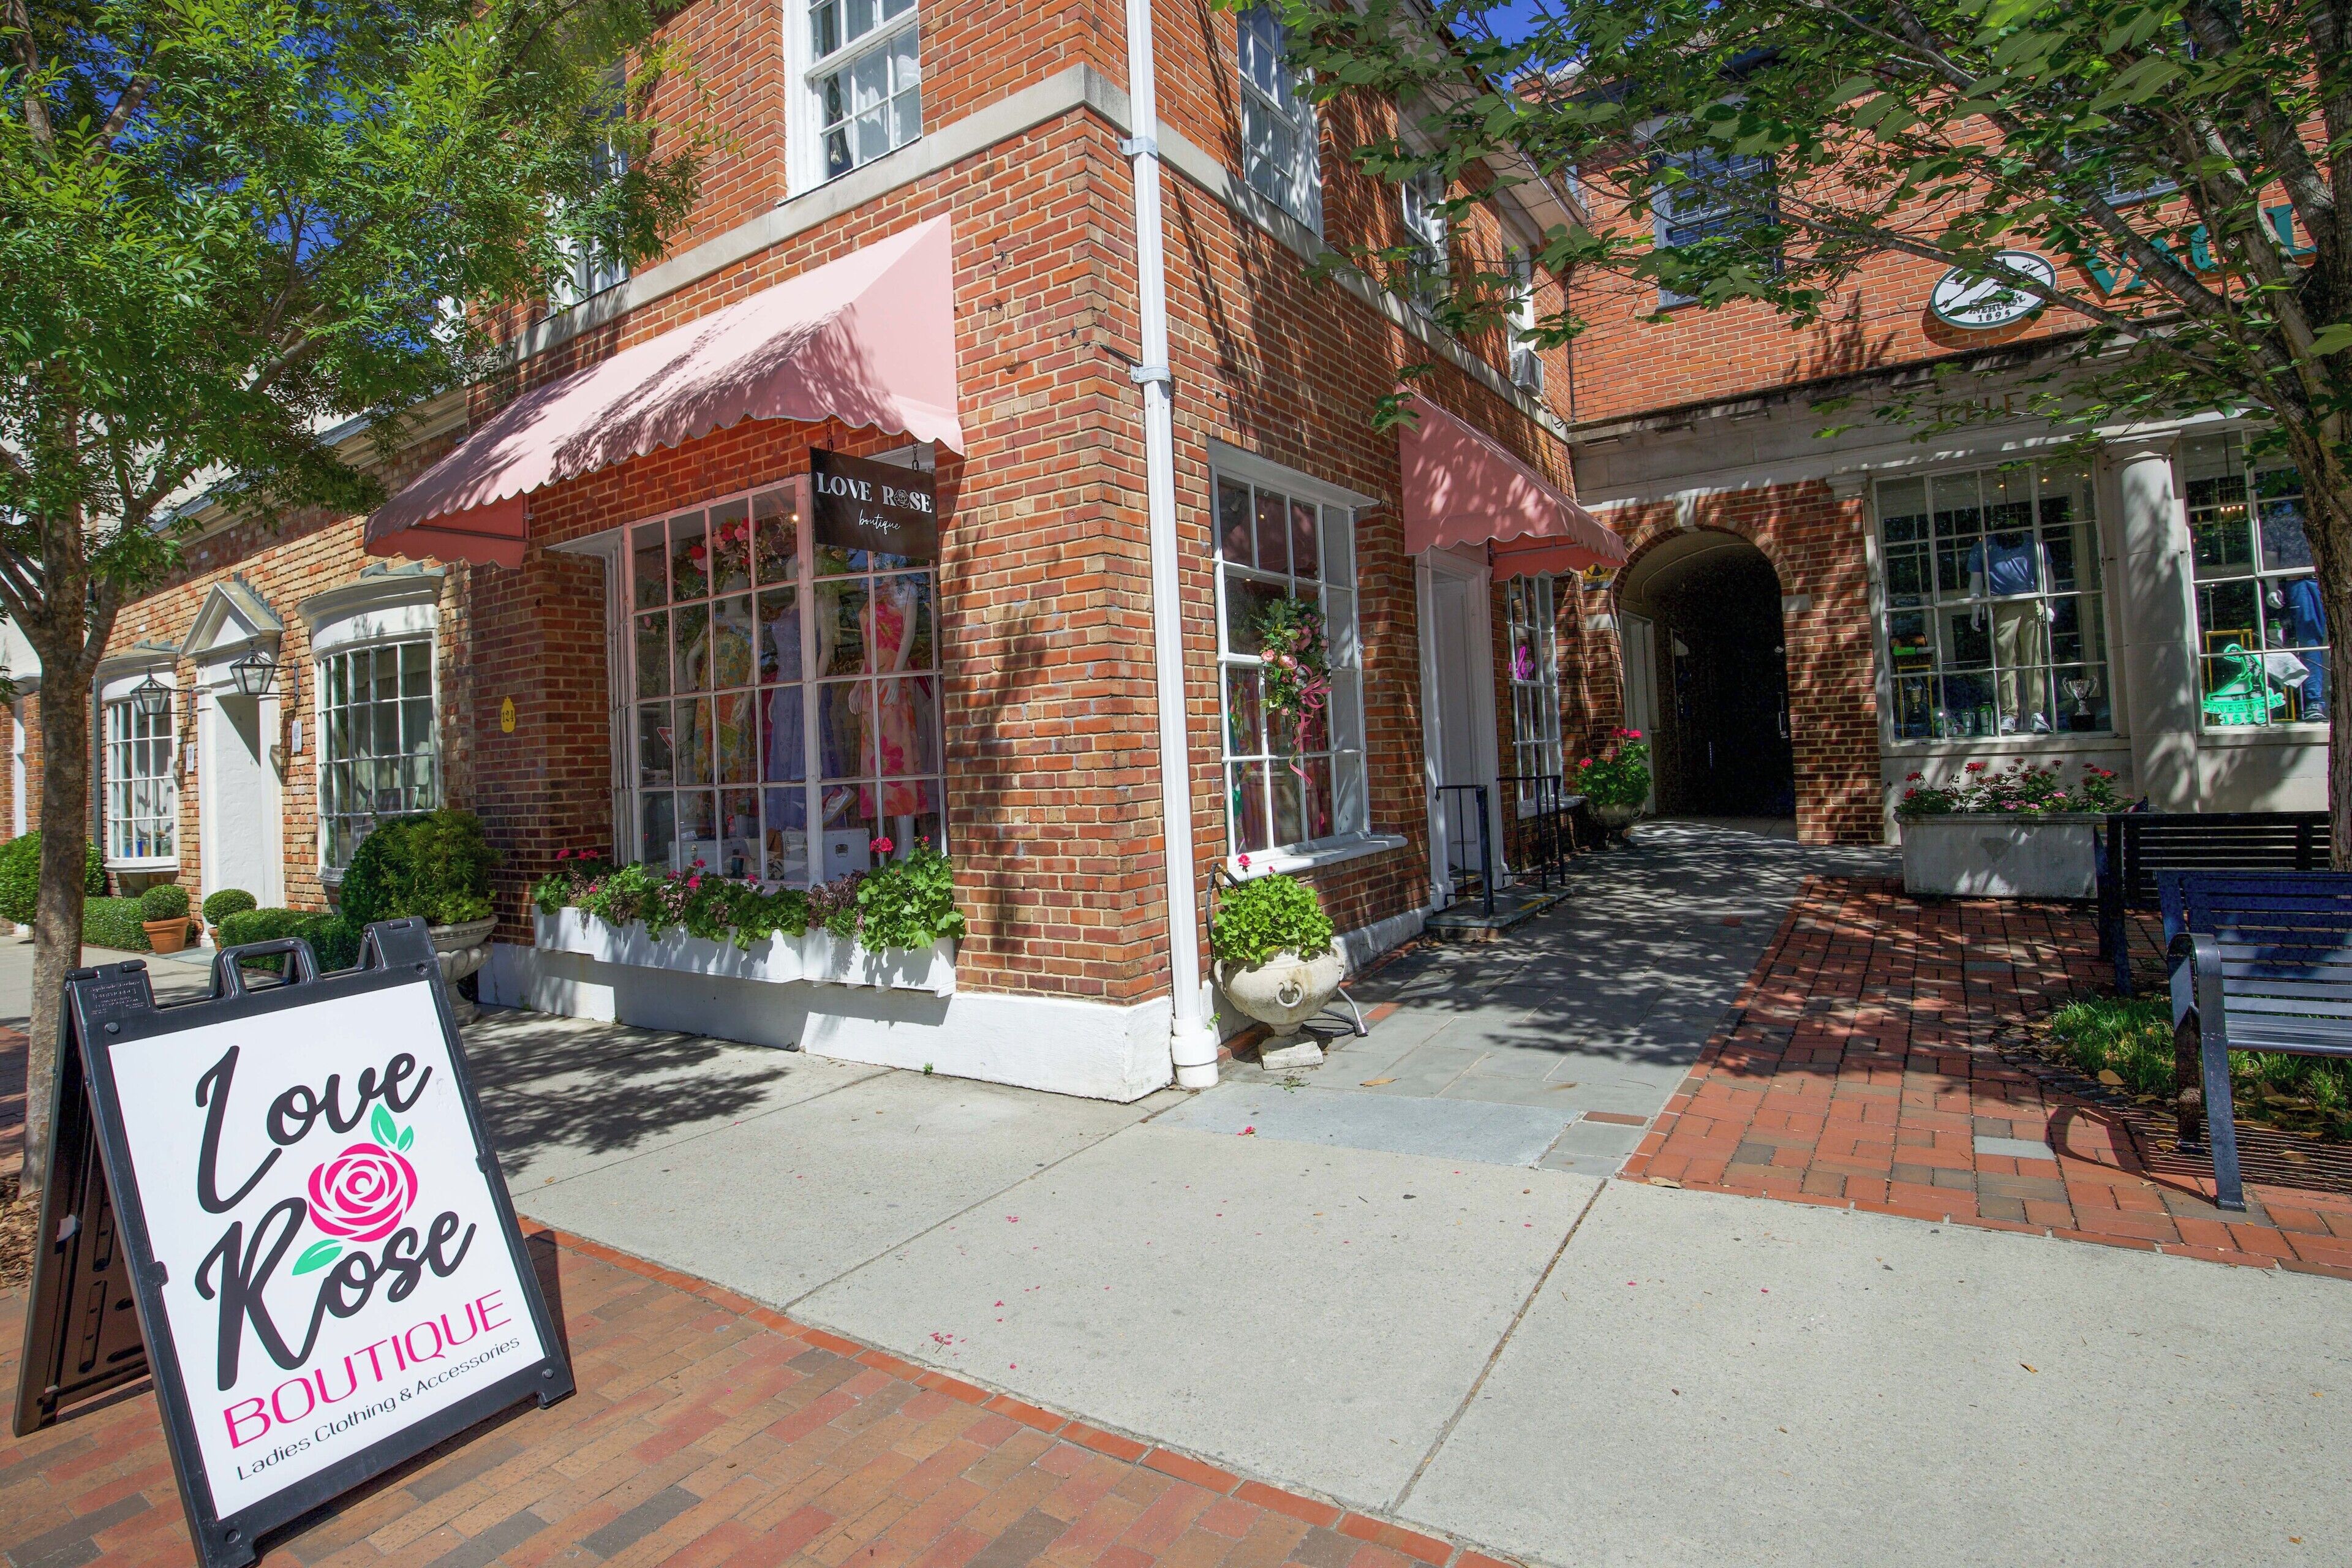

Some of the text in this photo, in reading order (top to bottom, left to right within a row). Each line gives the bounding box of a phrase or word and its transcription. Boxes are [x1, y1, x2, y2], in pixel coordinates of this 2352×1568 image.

[1978, 310, 2010, 322] 1895
[816, 472, 932, 513] LOVE ROSE
[859, 509, 900, 535] boutique
[2220, 711, 2266, 725] 1895
[195, 1044, 433, 1214] Love
[194, 1197, 477, 1392] Rose
[223, 1289, 512, 1449] BOUTIQUE
[237, 1336, 521, 1481] Ladies Clothing & Accessories
